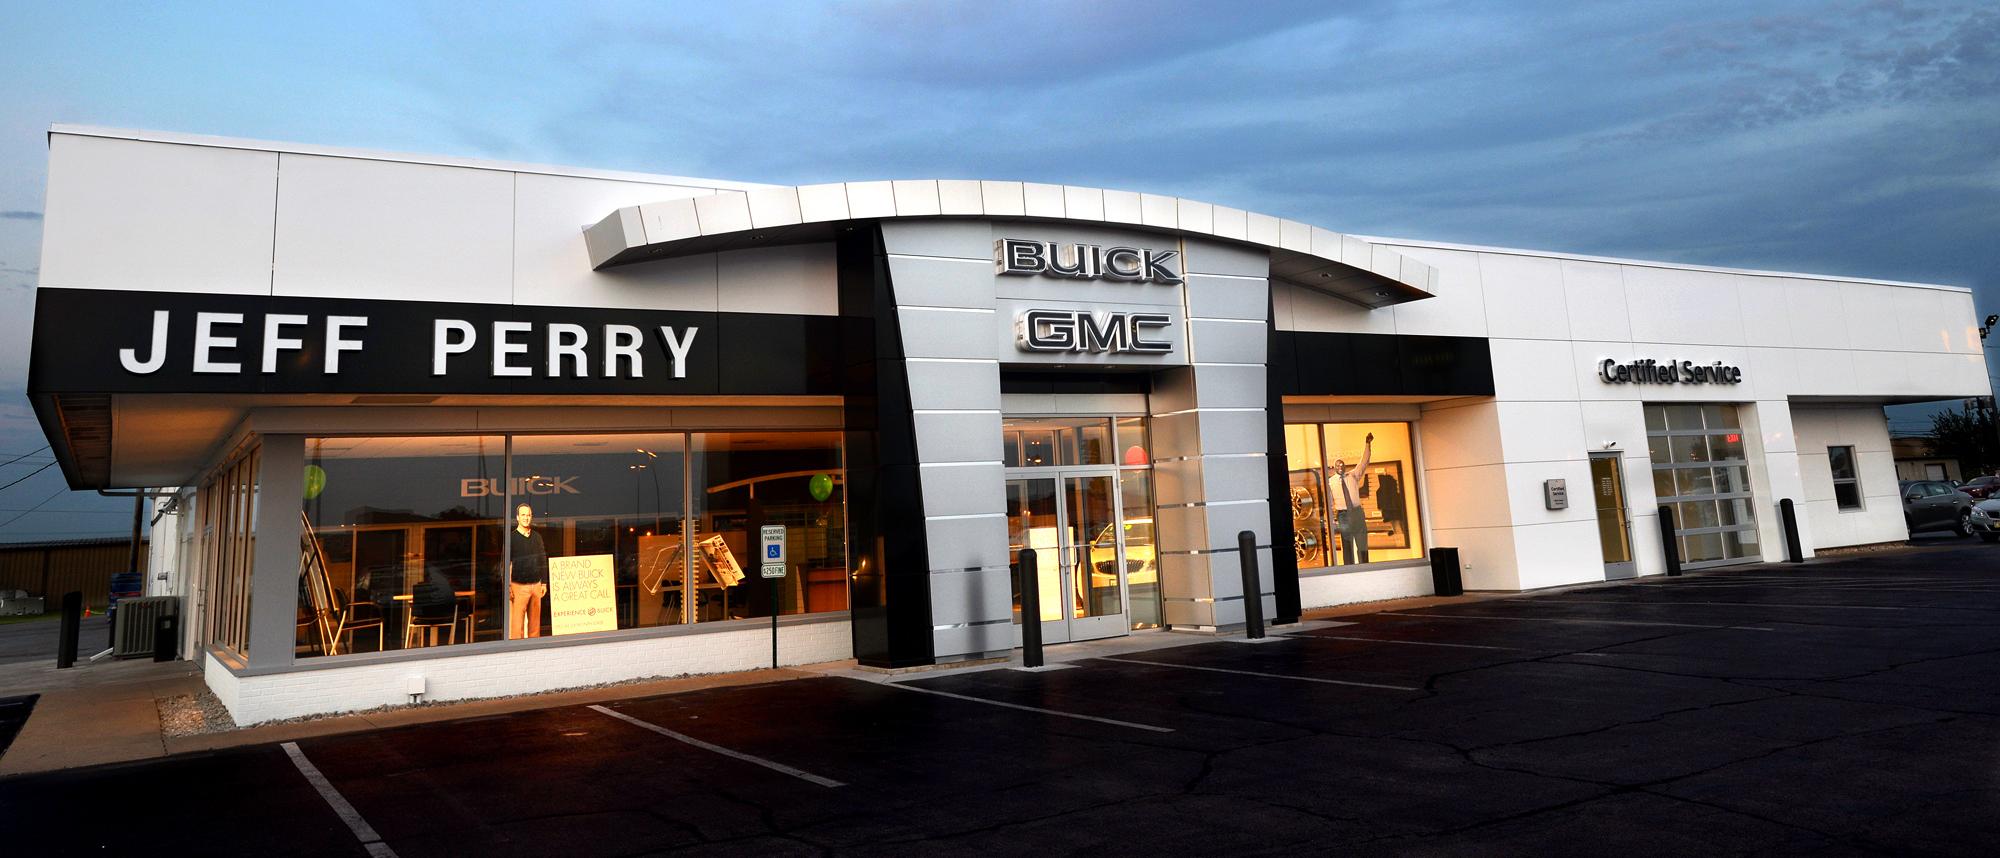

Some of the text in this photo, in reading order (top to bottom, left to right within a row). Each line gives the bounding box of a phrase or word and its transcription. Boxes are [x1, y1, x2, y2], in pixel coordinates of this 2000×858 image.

[996, 238, 1184, 286] BUICK
[1017, 309, 1173, 354] GMC
[119, 310, 699, 379] JEFF PERRY
[1599, 358, 1742, 384] Certified Service
[460, 476, 580, 497] BUICK
[552, 560, 592, 570] A BRAND
[552, 569, 604, 581] NEW BUICK
[552, 579, 599, 592] IS ALWAYS
[553, 593, 560, 601] A
[560, 590, 588, 602] GREAT
